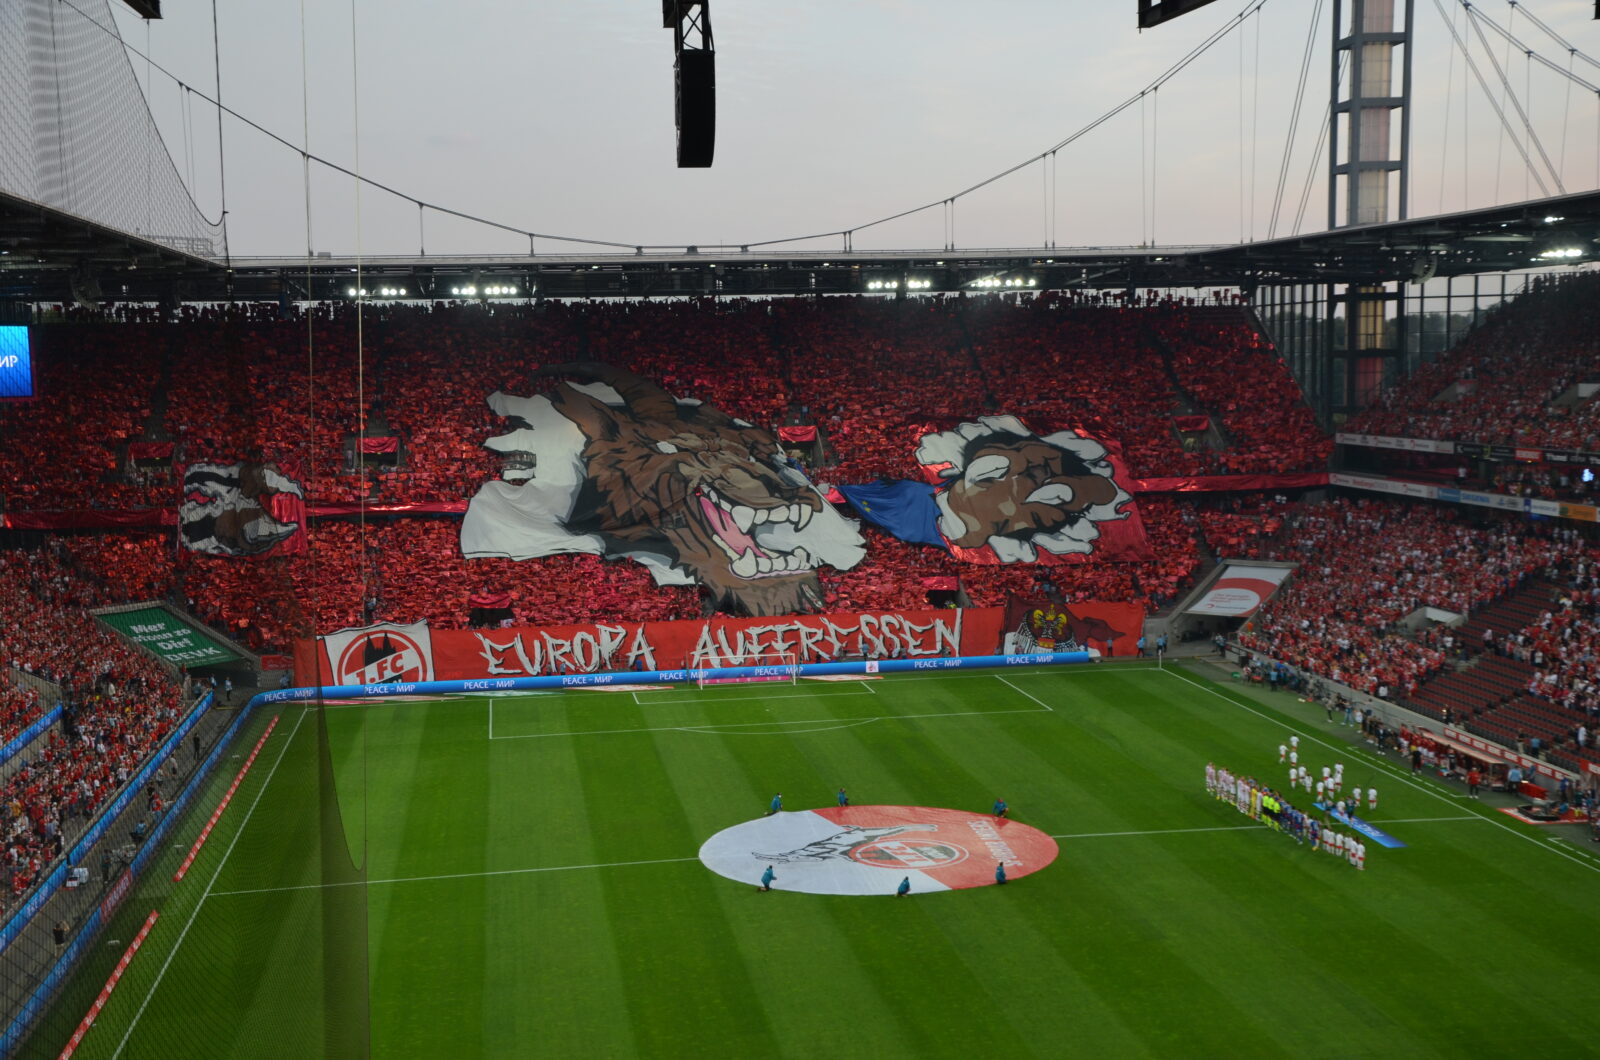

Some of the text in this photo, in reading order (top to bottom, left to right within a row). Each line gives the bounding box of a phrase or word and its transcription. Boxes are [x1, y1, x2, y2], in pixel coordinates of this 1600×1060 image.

[473, 608, 963, 676] EUROPA AUFFRESSEN
[914, 660, 937, 668] PEACE
[1006, 656, 1030, 664] PEACE
[356, 653, 404, 685] 1.FC
[754, 667, 779, 676] PEACE
[562, 676, 587, 685] PEACE
[660, 672, 684, 680] PEACE
[365, 685, 389, 694] PEACE
[264, 691, 288, 702] PEACE
